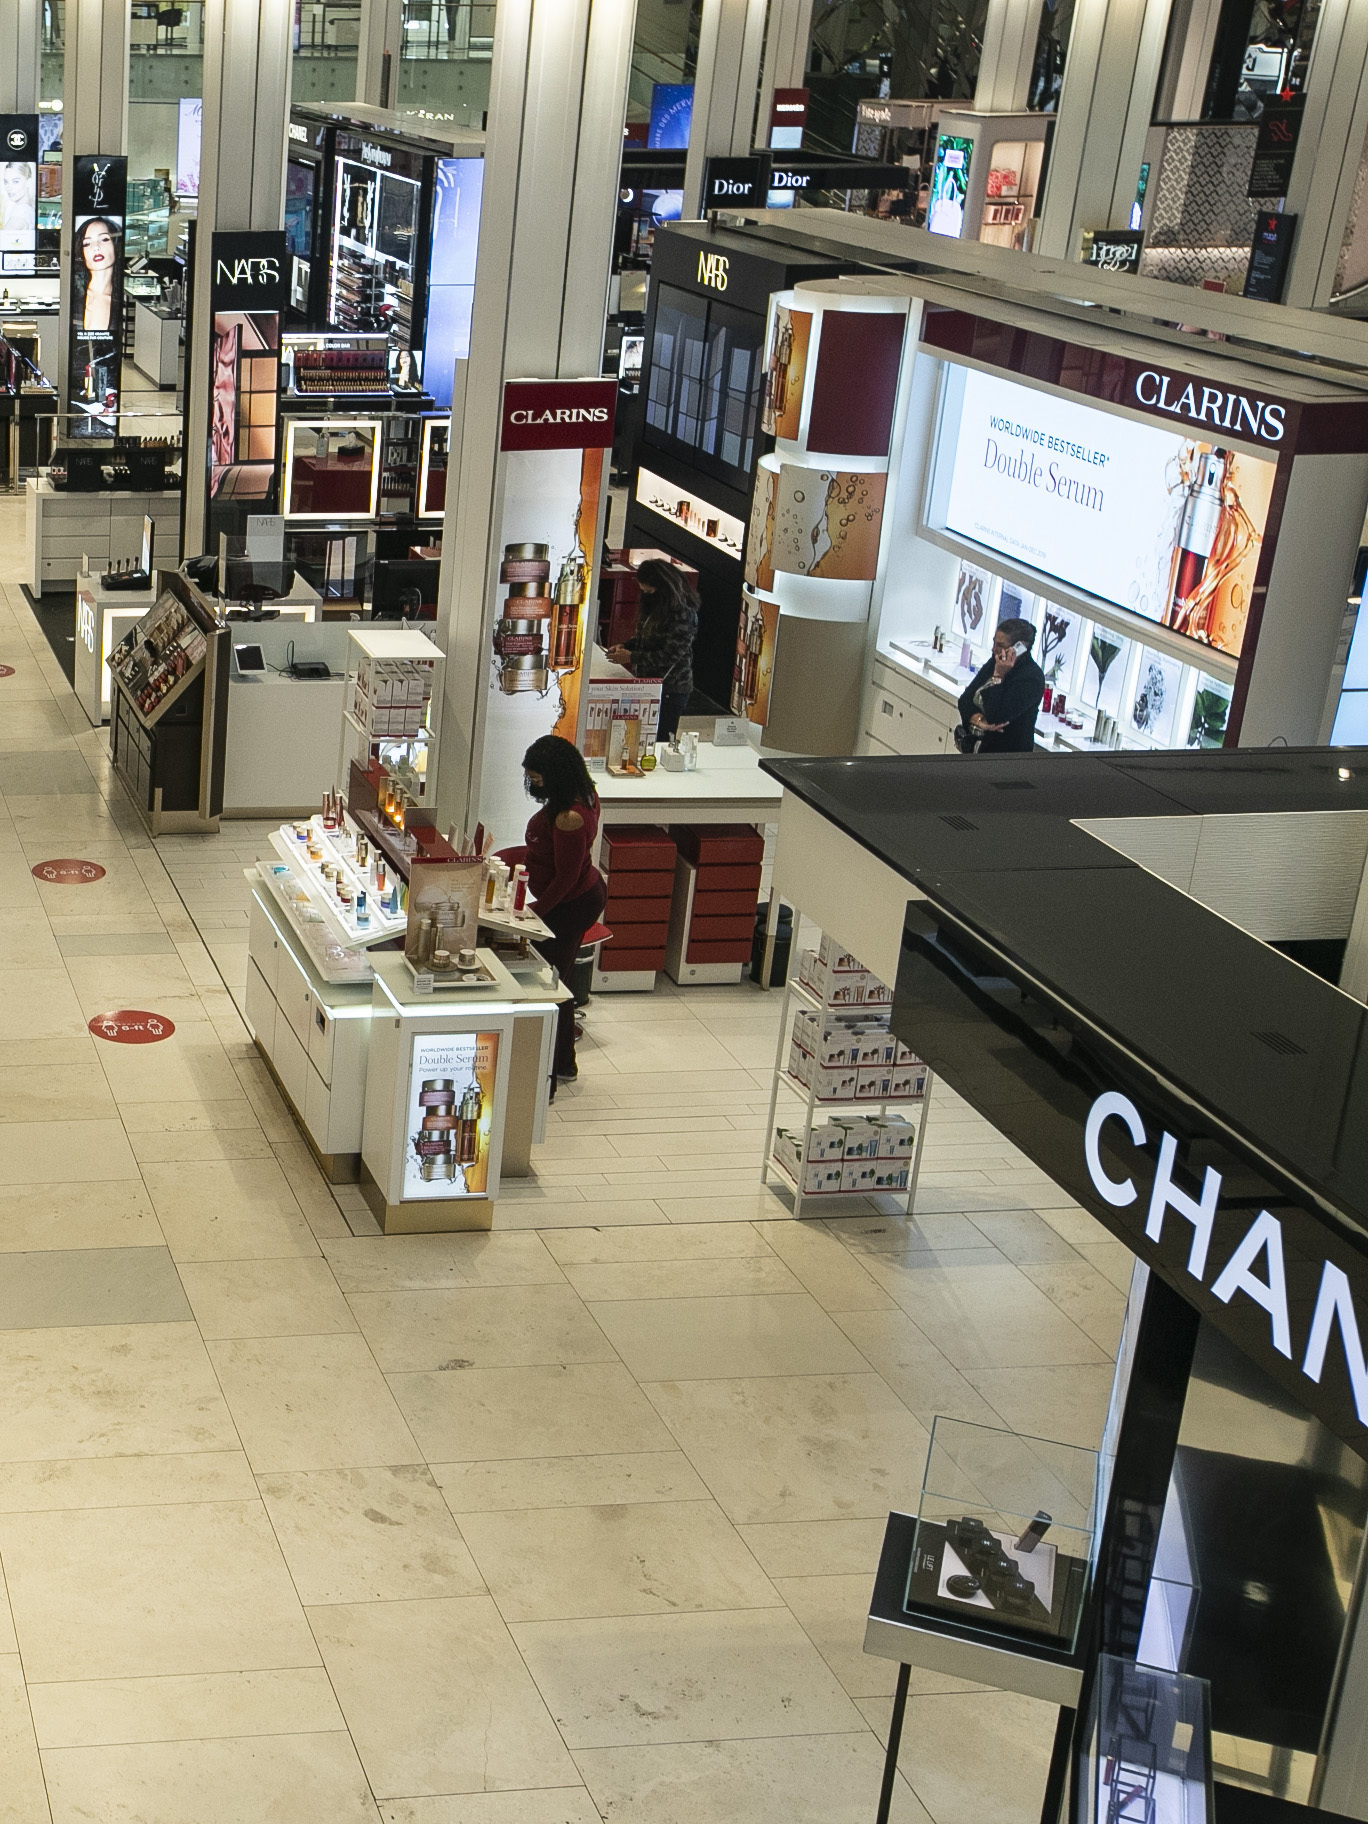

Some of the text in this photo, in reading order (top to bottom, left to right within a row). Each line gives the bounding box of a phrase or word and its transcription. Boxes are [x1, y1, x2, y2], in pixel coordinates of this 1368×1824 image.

[712, 178, 752, 196] Dior
[773, 171, 811, 188] Dior
[216, 257, 280, 286] NARS
[697, 250, 730, 292] NARS
[510, 407, 608, 425] CLARINS
[1134, 370, 1287, 441] CLARINS
[989, 414, 1046, 447] WORLDWIDE
[983, 438, 1105, 512] Double Serum
[77, 594, 95, 654] NARS
[419, 1053, 489, 1065] Double Serum
[1084, 1091, 1368, 1428] CHAN
